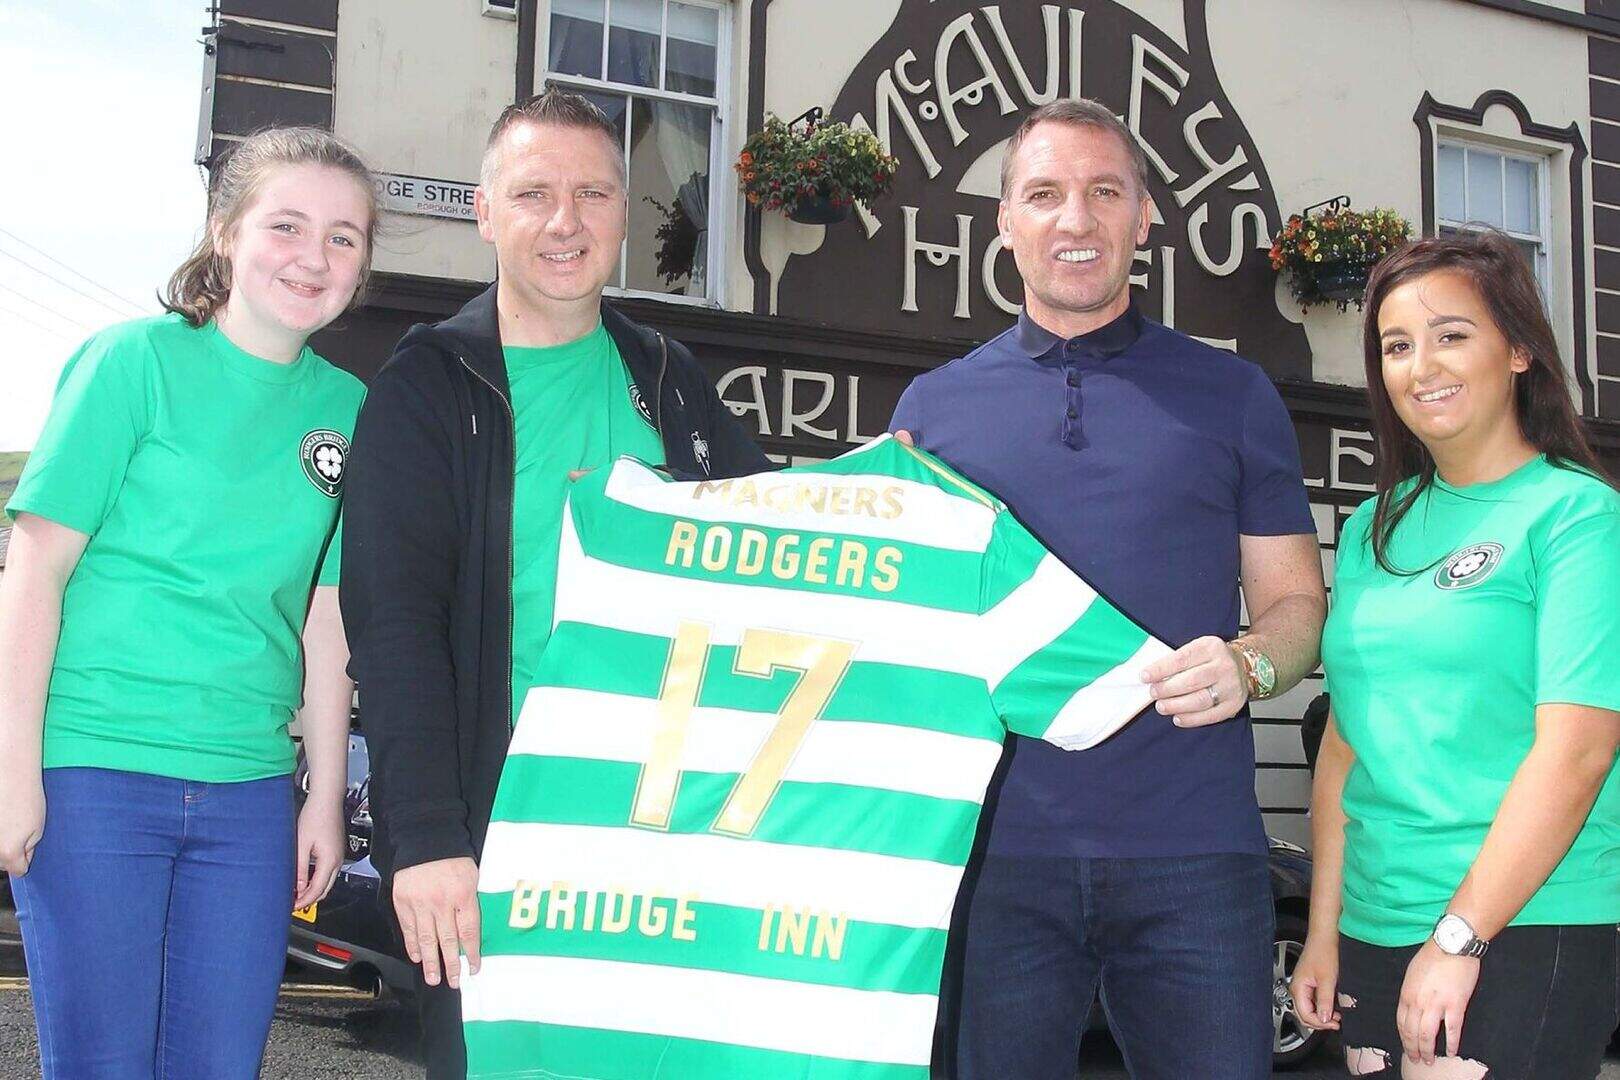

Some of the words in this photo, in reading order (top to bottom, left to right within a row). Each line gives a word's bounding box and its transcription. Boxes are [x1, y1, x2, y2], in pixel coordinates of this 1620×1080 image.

[376, 180, 414, 198] DGE
[424, 185, 475, 205] STRE
[417, 203, 458, 214] BOROUGH
[461, 208, 472, 216] OF
[692, 479, 904, 519] MAGNERS
[664, 520, 903, 592] RODGERS
[628, 617, 862, 839] 17
[507, 879, 699, 942] BRIDGE
[757, 902, 848, 961] INN
